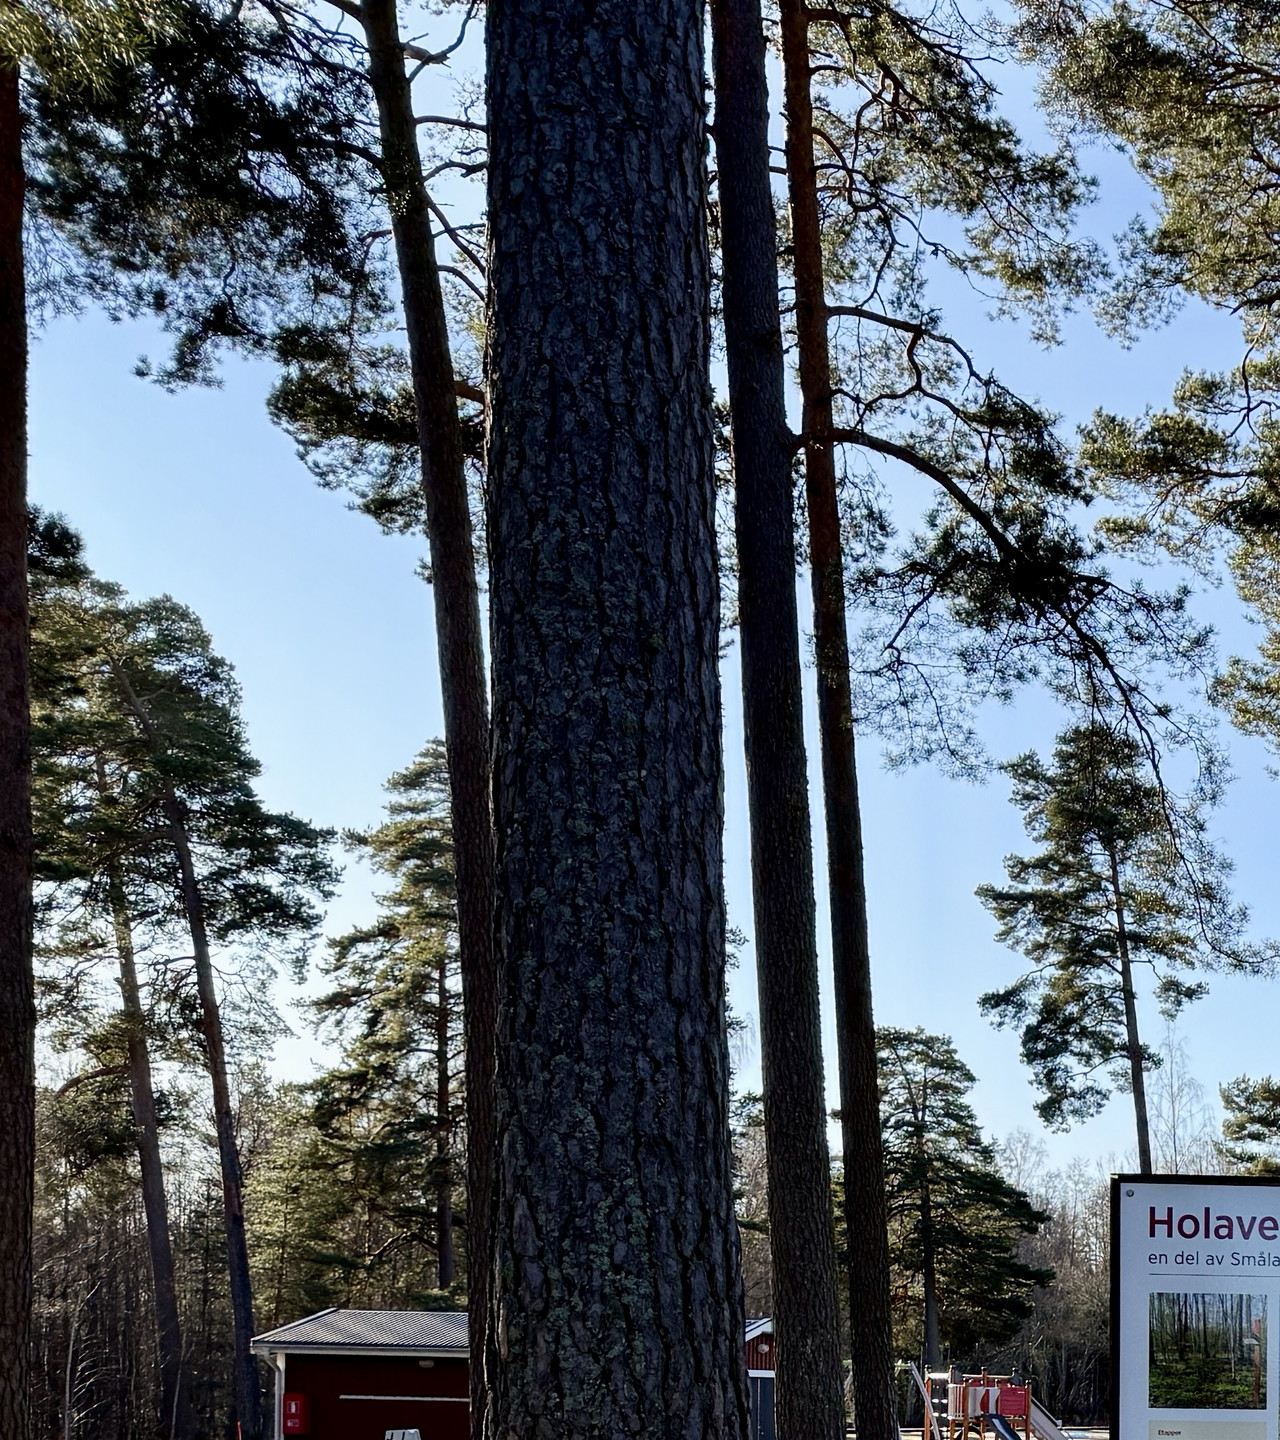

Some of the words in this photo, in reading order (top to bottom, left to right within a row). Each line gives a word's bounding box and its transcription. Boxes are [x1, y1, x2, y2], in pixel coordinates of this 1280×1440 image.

[1147, 1253, 1168, 1265] en
[1174, 1250, 1199, 1265] del
[1205, 1254, 1225, 1266] av
